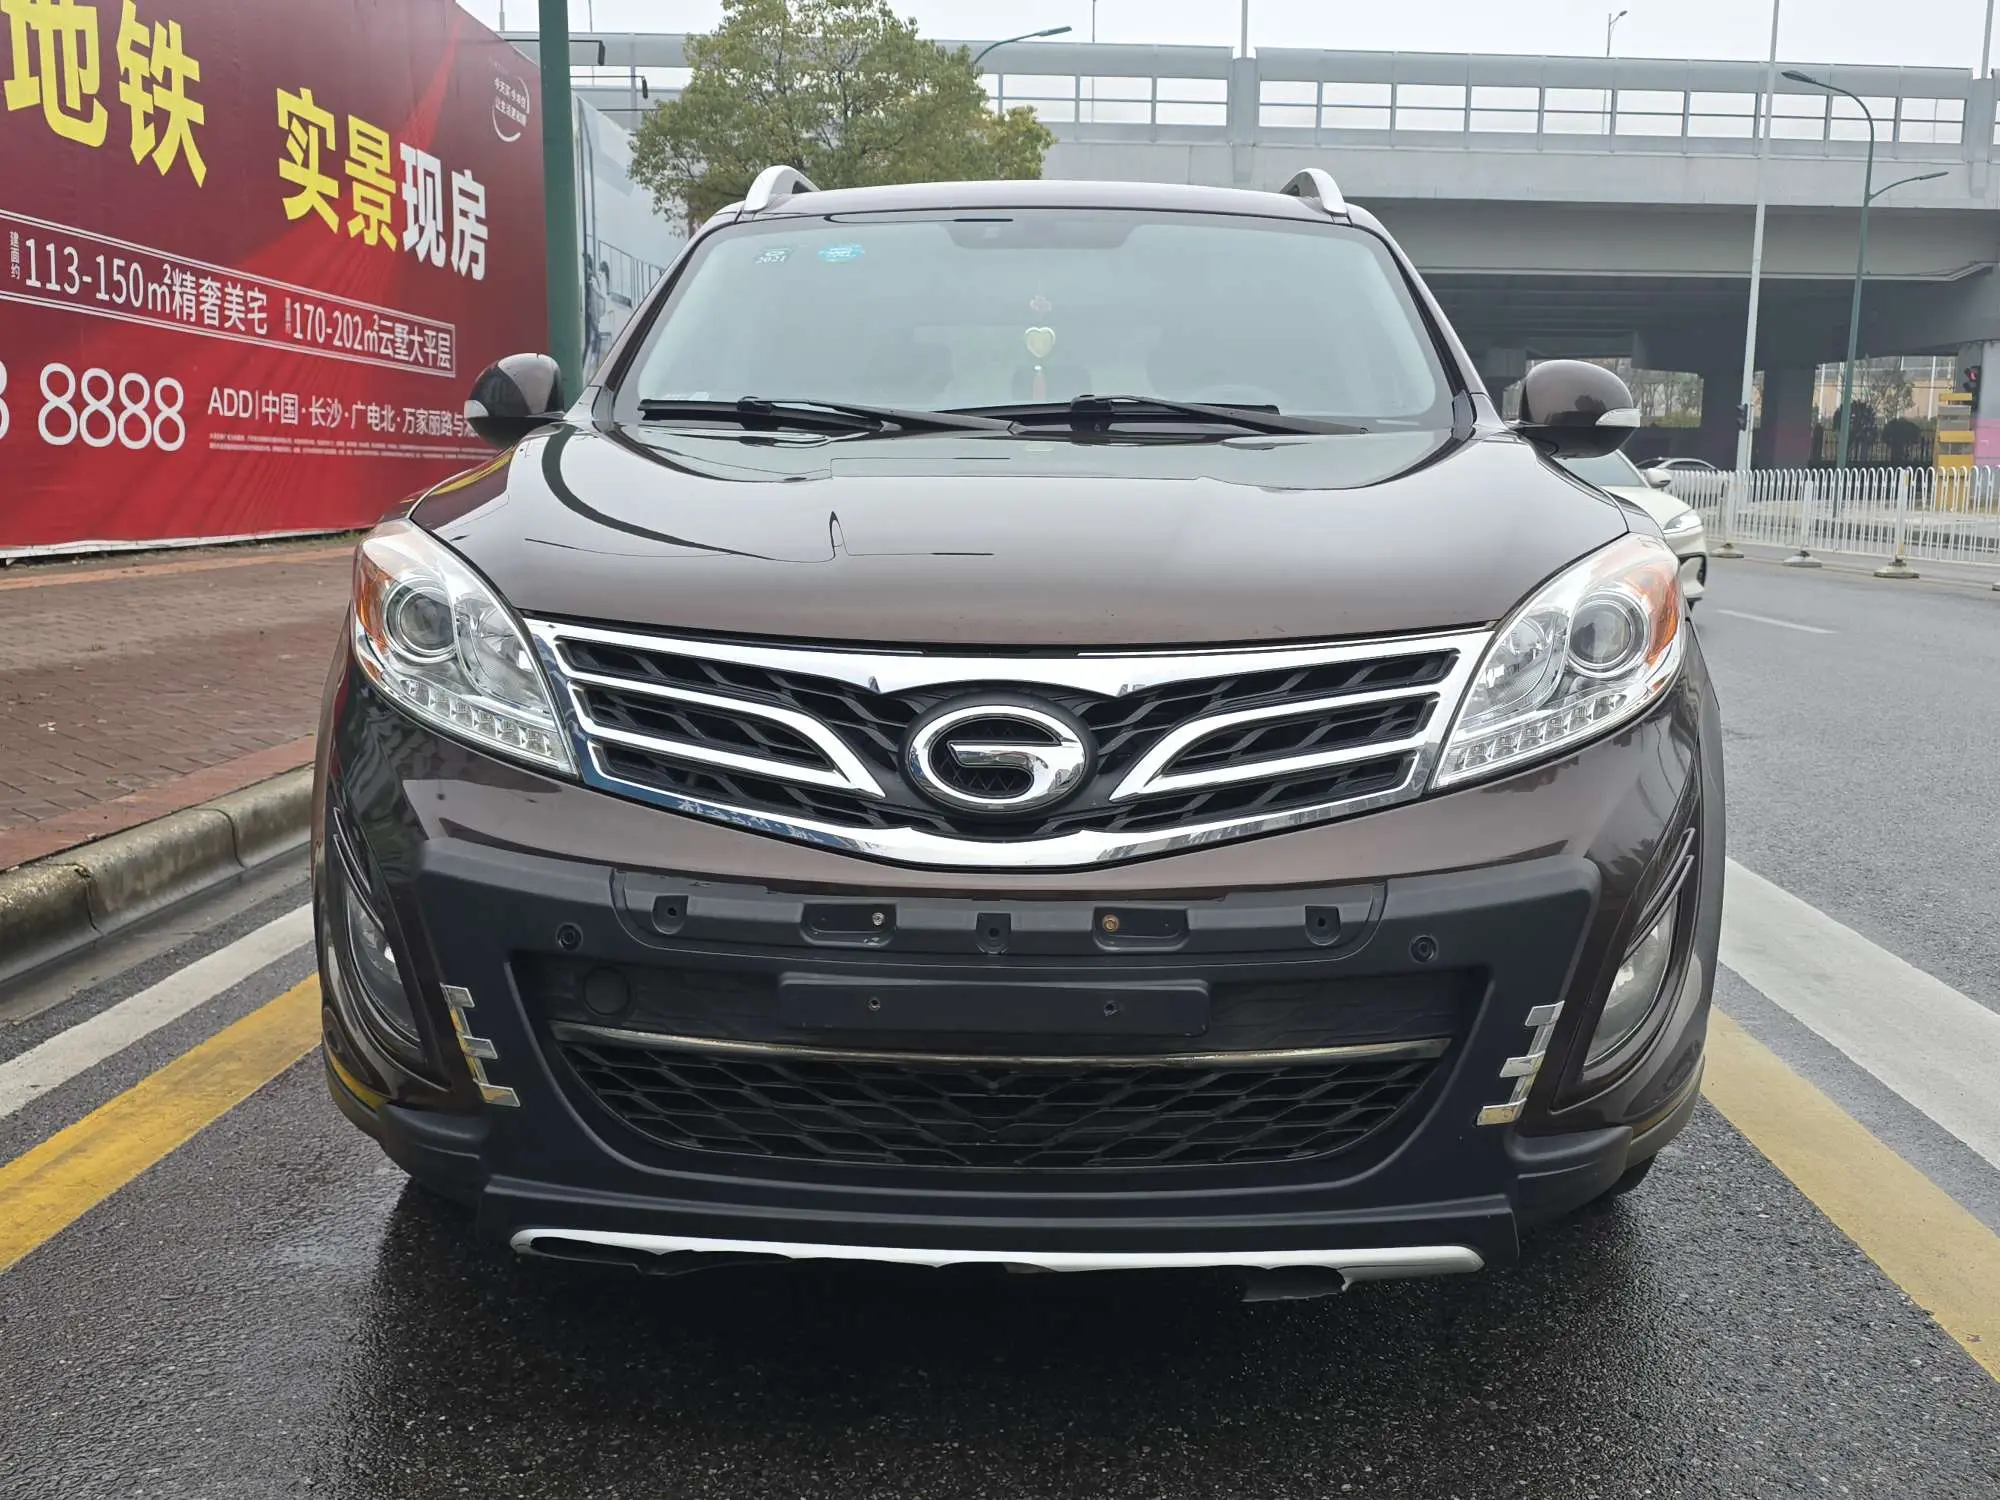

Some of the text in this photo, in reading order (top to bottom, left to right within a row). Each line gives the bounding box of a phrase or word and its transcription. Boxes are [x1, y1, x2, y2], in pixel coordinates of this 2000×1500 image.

[2, 0, 488, 281] 地铁 实景现房
[38, 362, 186, 452] 8888
